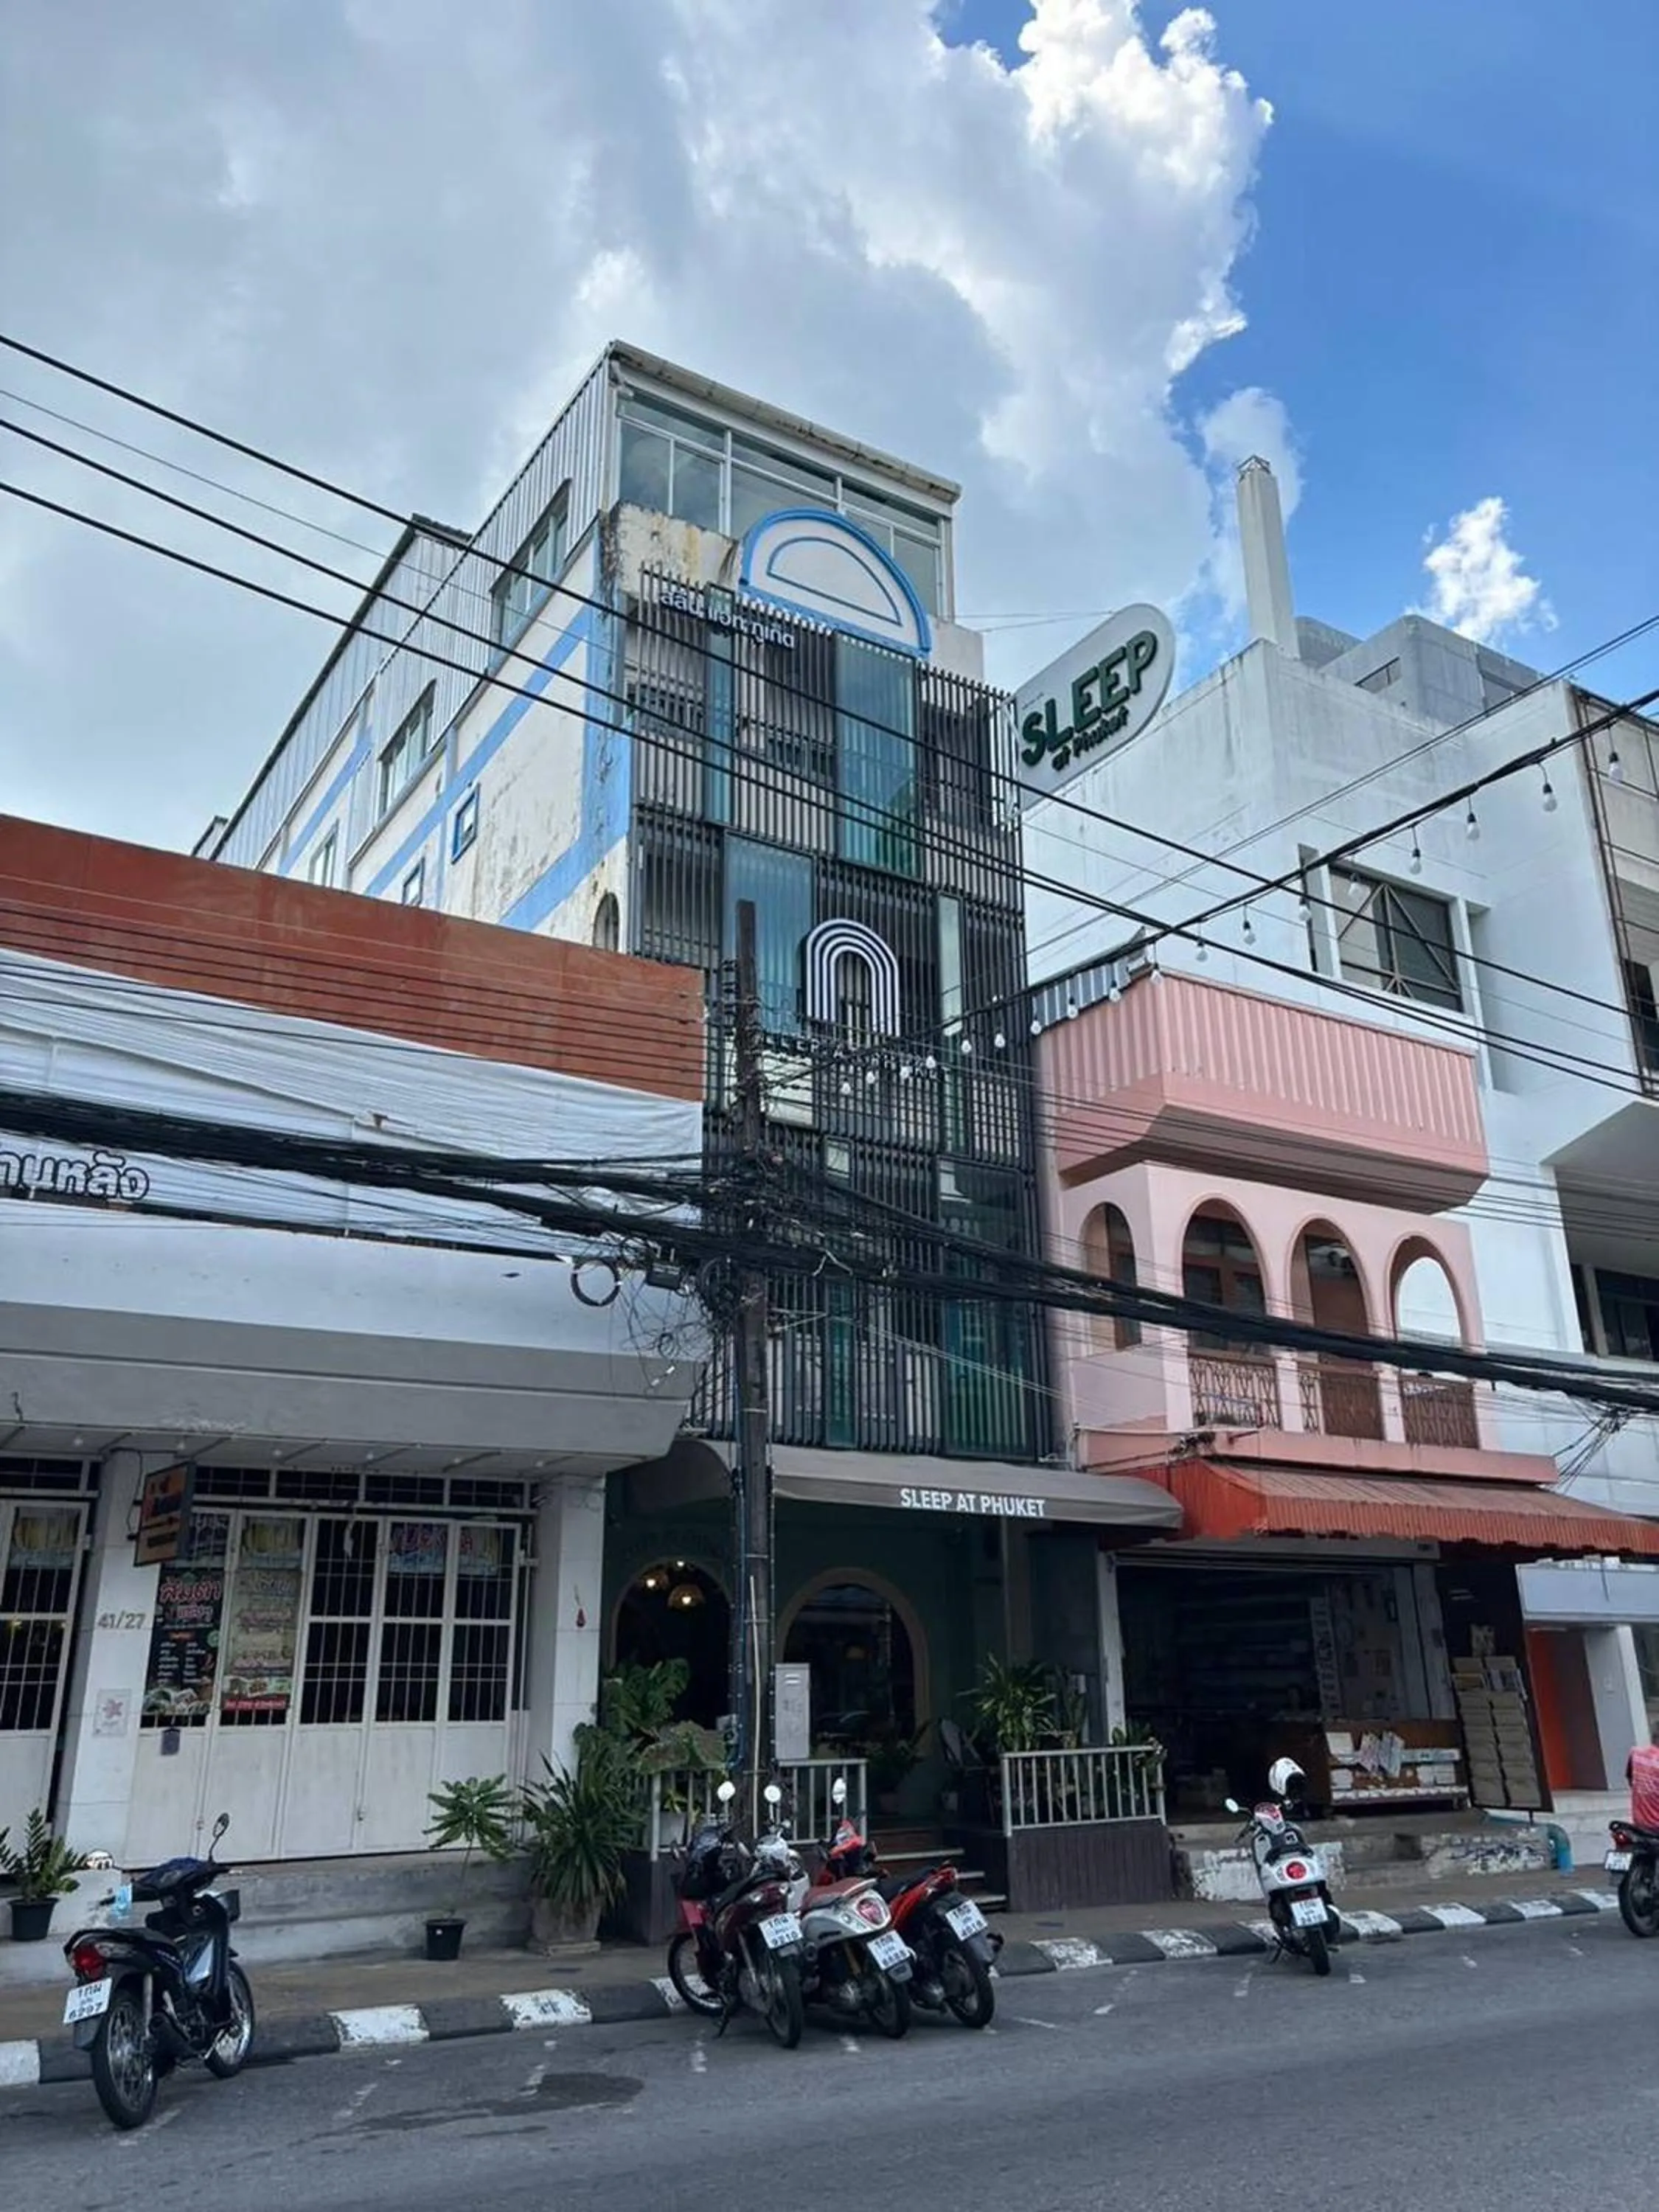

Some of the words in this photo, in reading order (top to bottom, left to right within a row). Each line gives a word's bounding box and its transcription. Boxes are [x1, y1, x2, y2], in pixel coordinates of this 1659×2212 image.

[1021, 630, 1158, 766] SLEEP
[1051, 744, 1071, 771] at
[1073, 705, 1129, 758] Phuket
[900, 1488, 953, 1510] SLEEP
[956, 1493, 977, 1512] AT
[980, 1495, 1046, 1517] PHUKET
[98, 1610, 146, 1630] 41/27
